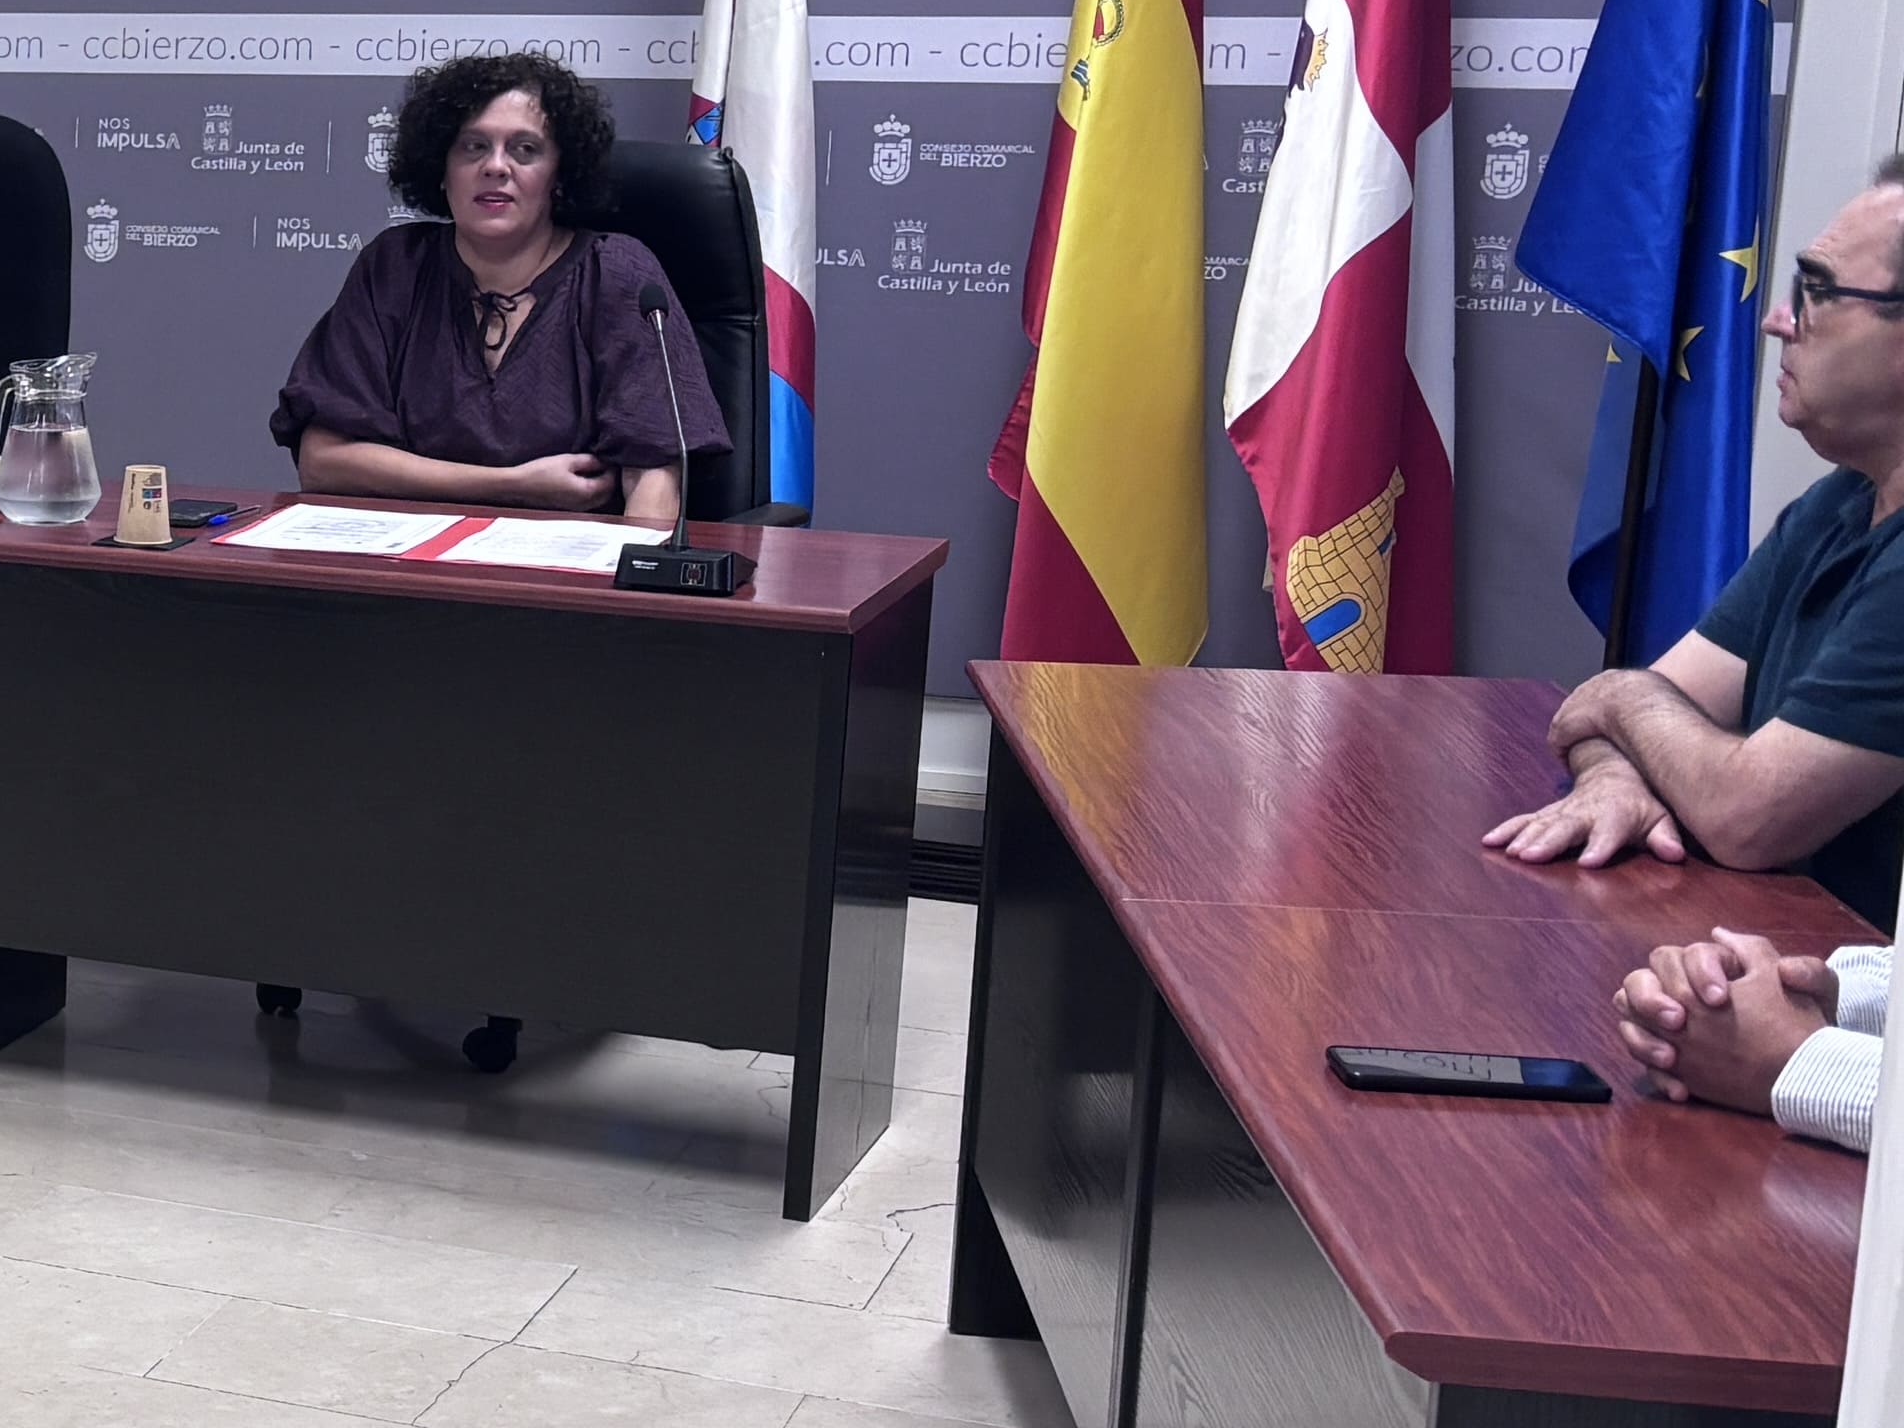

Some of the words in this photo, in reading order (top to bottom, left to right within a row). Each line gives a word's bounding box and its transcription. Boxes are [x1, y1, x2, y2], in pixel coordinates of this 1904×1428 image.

[83, 27, 314, 61] ccbierzo.com
[355, 27, 601, 64] ccbierzocom
[98, 117, 130, 130] NOS
[97, 132, 181, 152] IMPULSA
[234, 141, 280, 155] Junta
[284, 141, 305, 155] de
[190, 156, 247, 171] Castilla
[249, 160, 261, 175] y
[264, 157, 305, 172] León
[940, 152, 1007, 168] BIERZO
